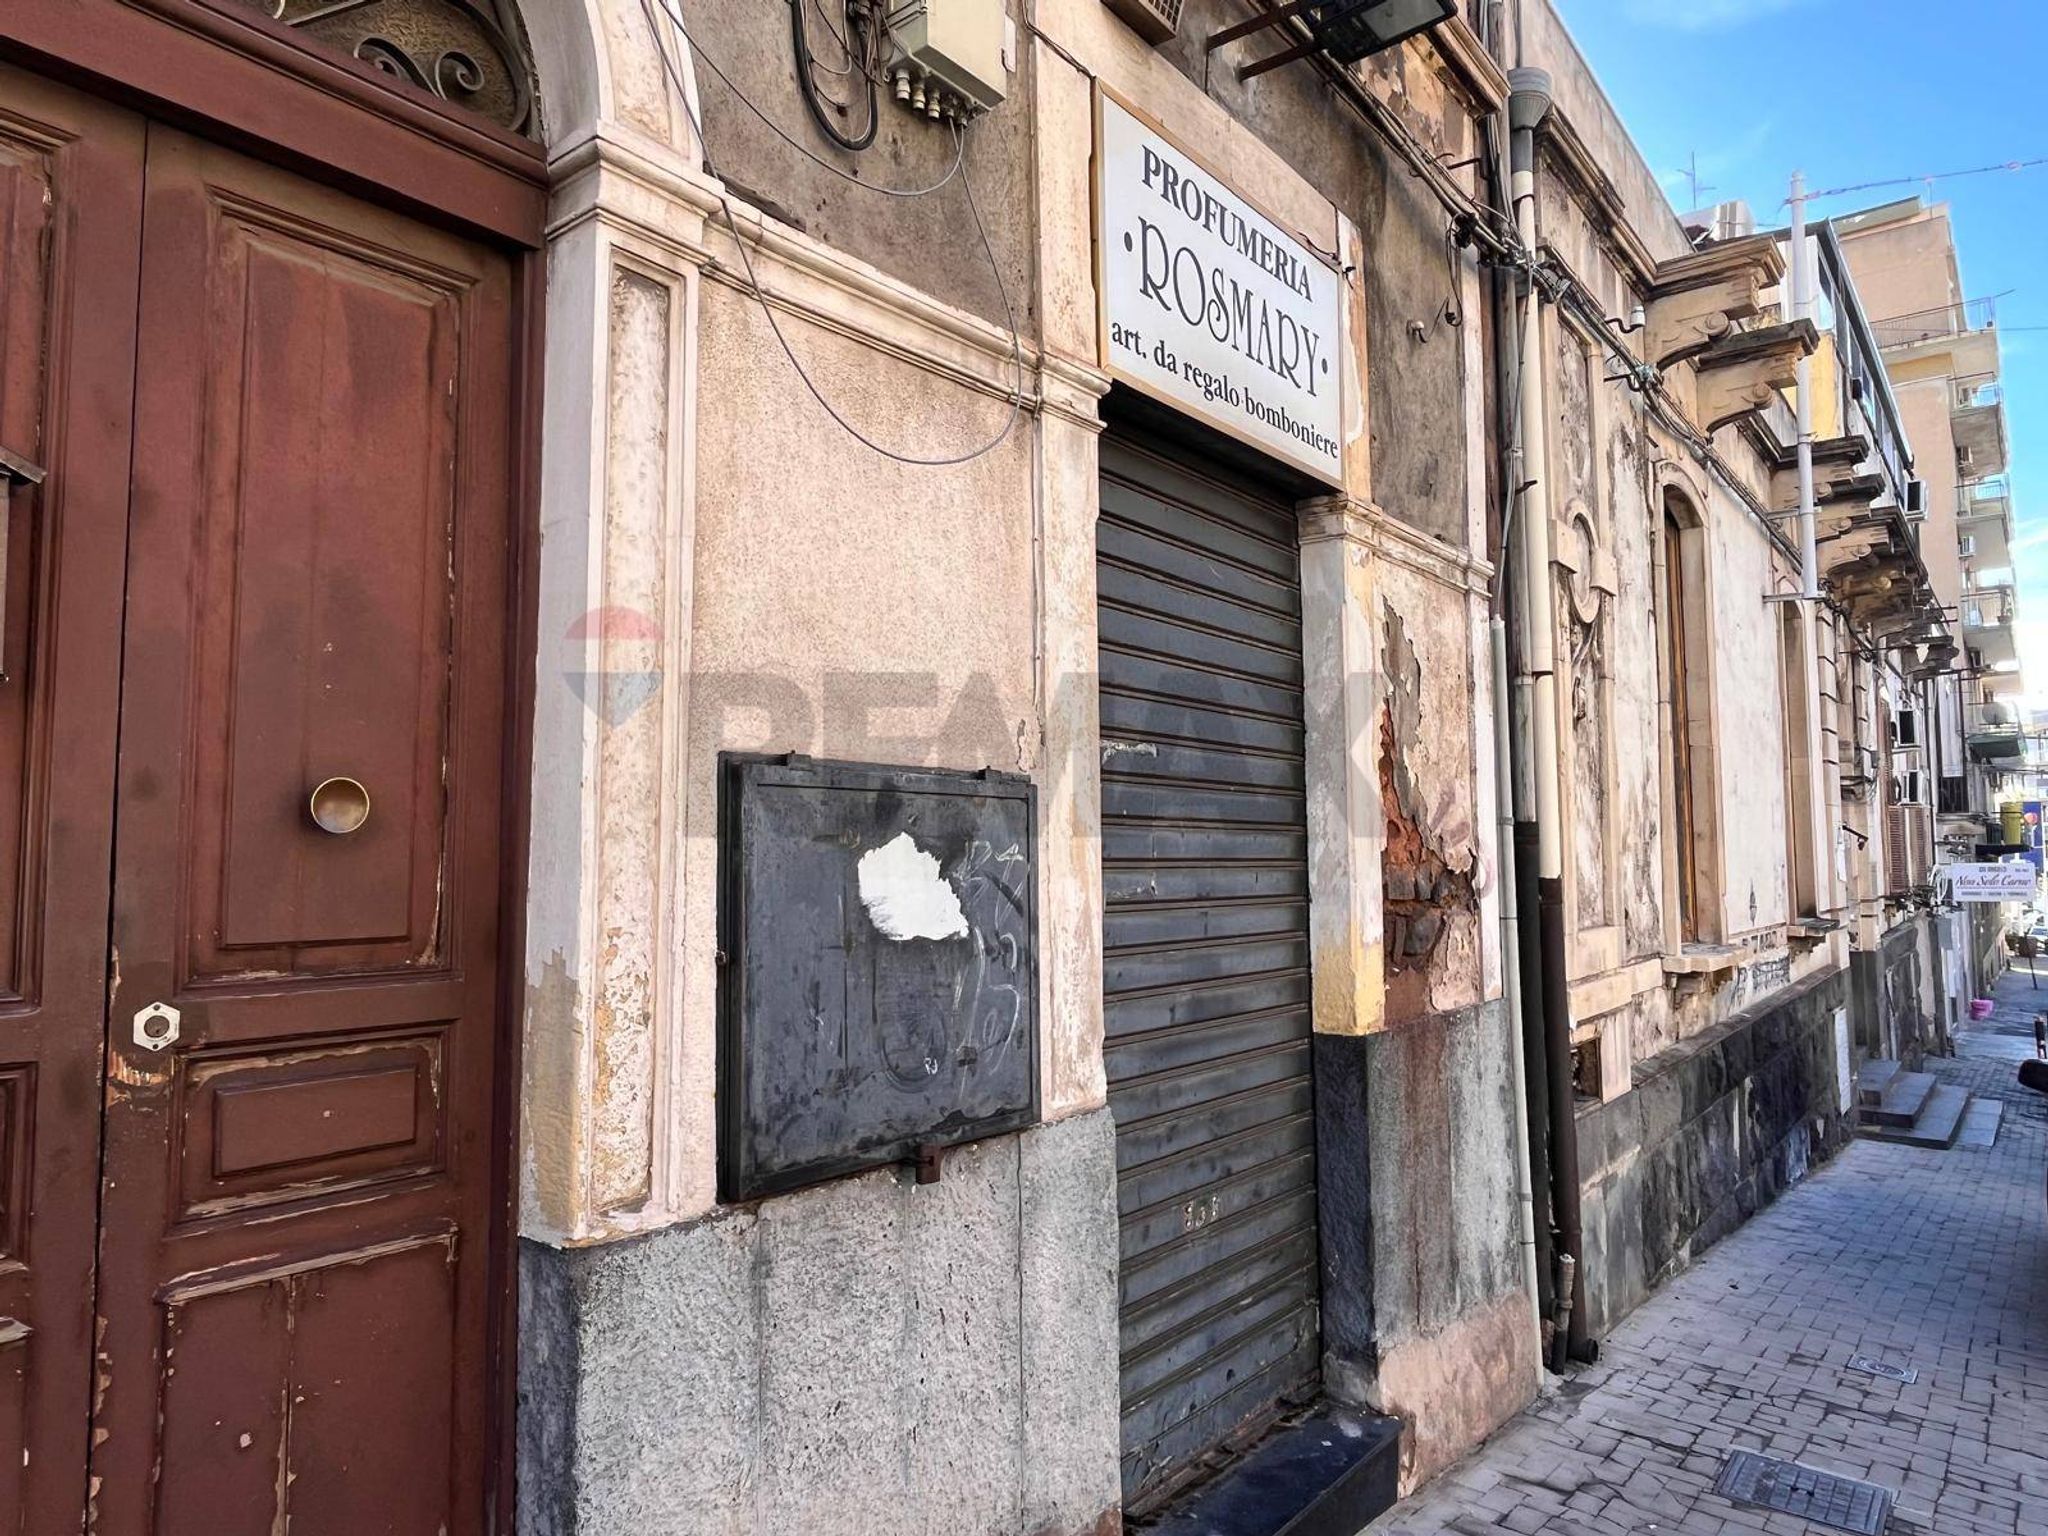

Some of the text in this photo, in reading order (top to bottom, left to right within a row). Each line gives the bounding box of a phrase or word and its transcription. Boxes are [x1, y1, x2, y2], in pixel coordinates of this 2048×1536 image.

[1142, 144, 1312, 302] PROFUMERIA
[1137, 216, 1320, 396] ROSMARY
[1111, 321, 1338, 459] art. da regalo bomboniere
